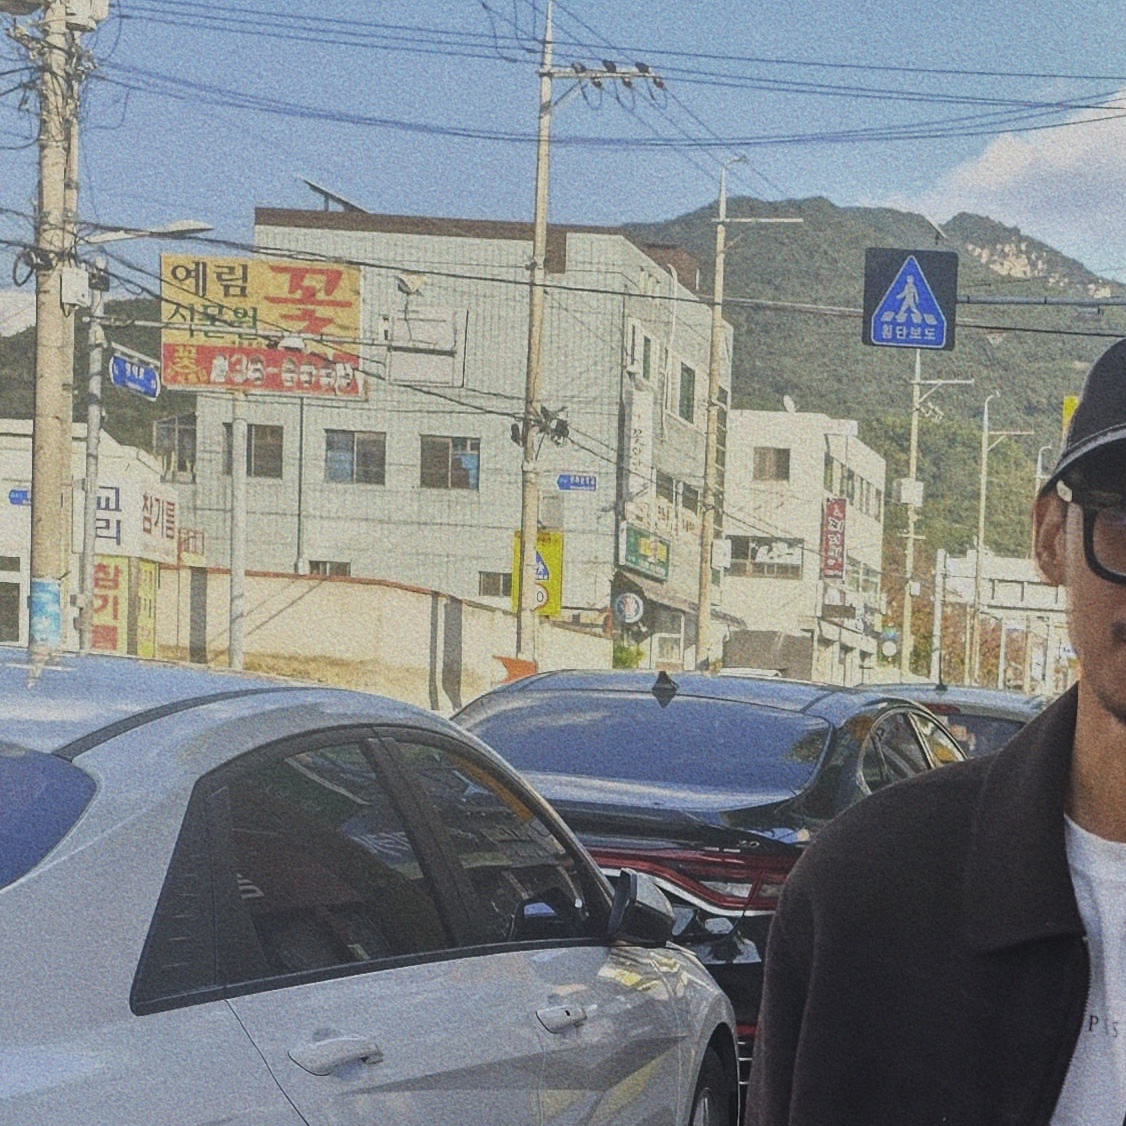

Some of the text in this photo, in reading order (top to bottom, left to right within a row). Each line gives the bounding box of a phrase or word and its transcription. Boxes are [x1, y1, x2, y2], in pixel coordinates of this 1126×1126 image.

[171, 261, 249, 298] 예림
[263, 264, 354, 343] 꽃
[882, 323, 937, 341] 횡단보도
